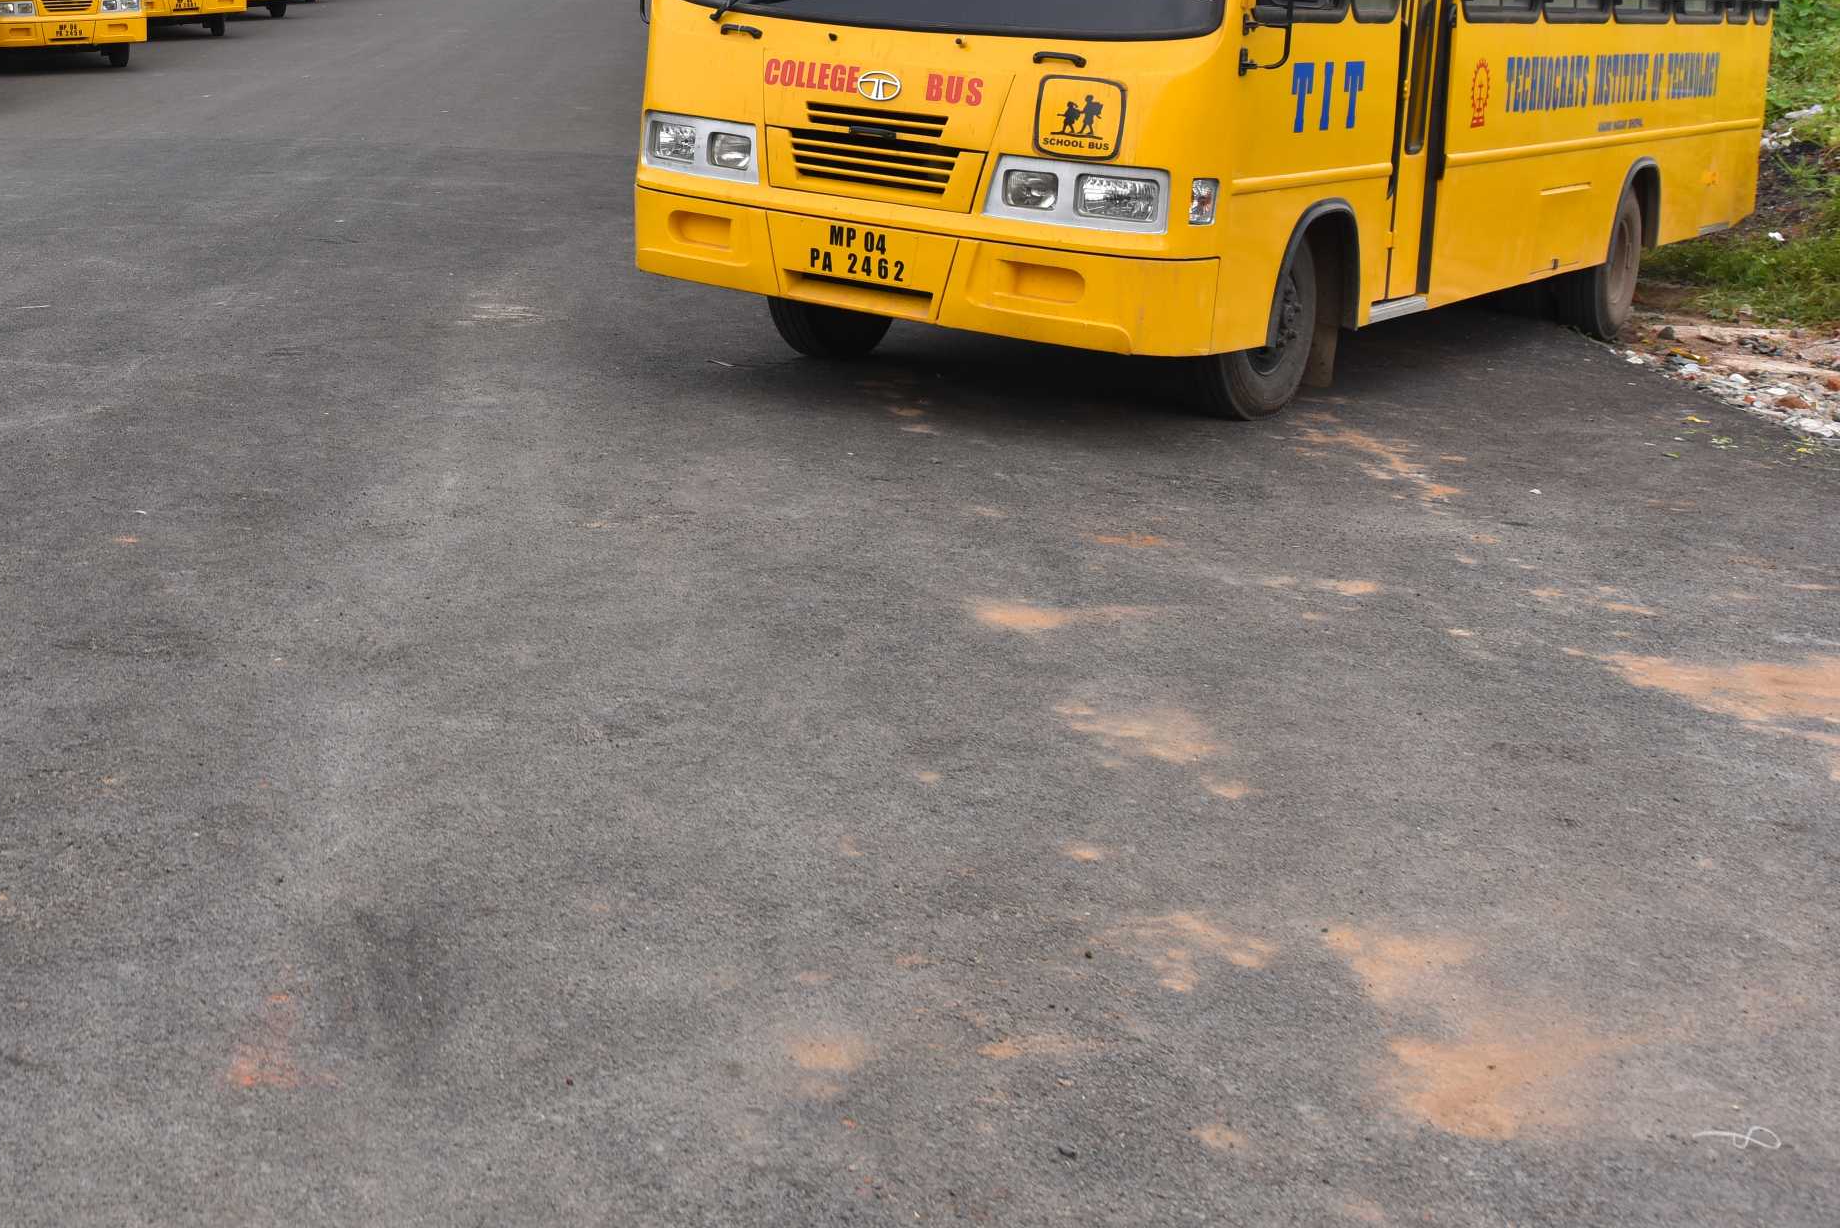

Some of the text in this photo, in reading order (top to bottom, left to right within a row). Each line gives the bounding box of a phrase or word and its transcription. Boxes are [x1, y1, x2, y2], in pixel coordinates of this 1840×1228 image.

[764, 58, 984, 106] COLLEGE BUS
[1292, 60, 1365, 133] TIT
[1505, 52, 1721, 113] TECHNOCRATS INSTITUTE OF TECHNOLOGY
[1042, 137, 1110, 151] SCHOOL BUS
[829, 225, 886, 255] MP 04
[810, 247, 905, 282] PA 2462
